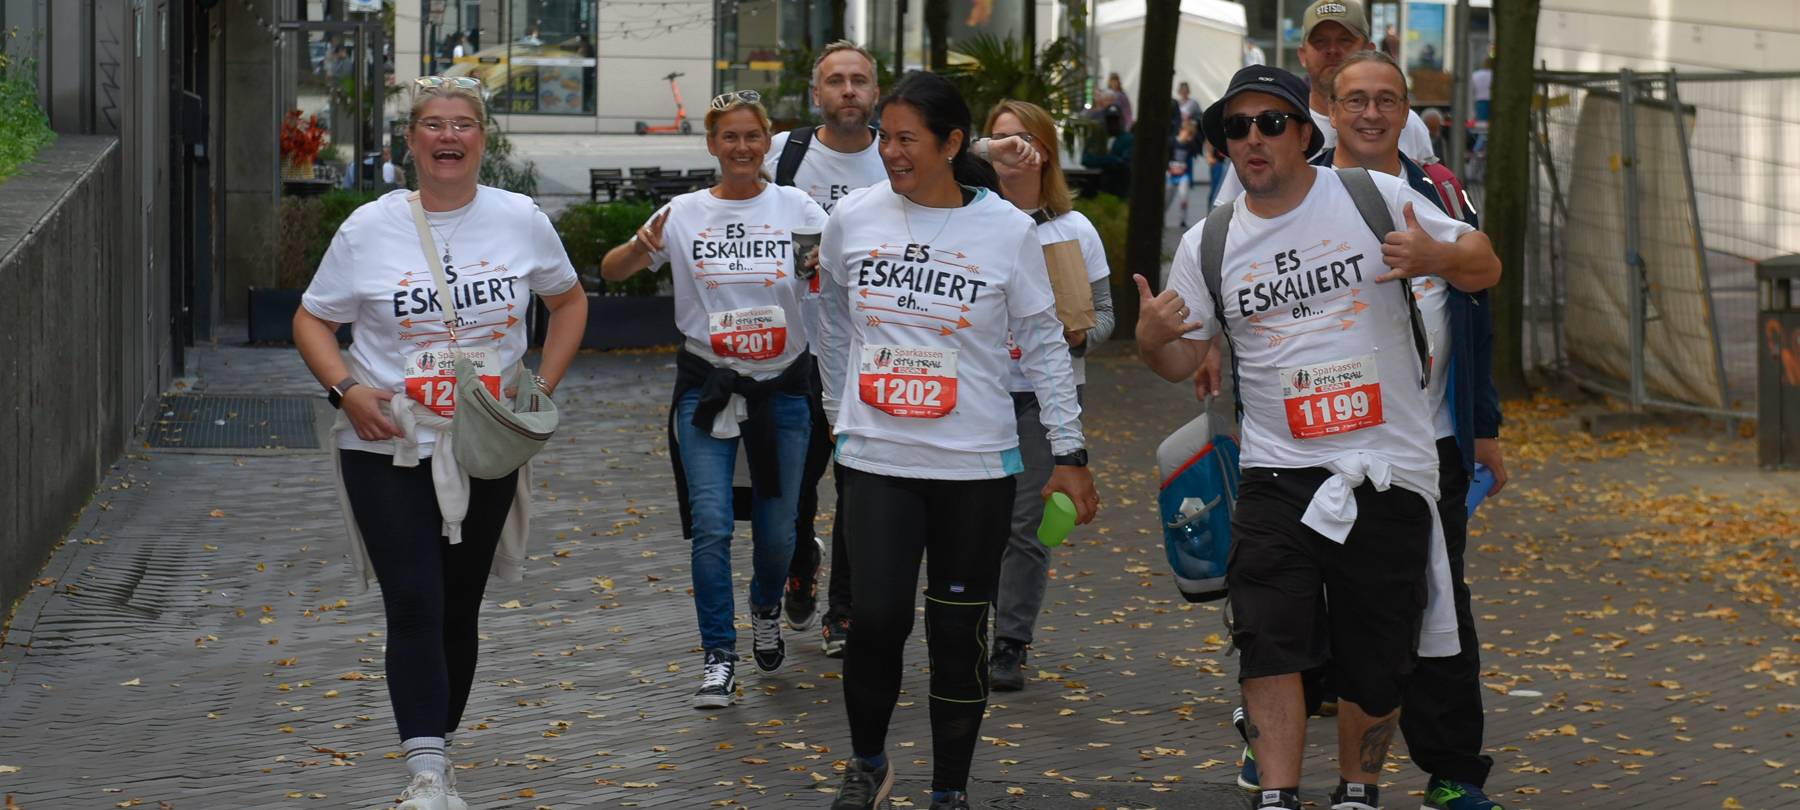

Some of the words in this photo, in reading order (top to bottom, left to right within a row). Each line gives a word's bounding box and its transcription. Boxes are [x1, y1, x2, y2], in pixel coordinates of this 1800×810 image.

[726, 223, 745, 239] ES
[692, 240, 790, 260] ESKALIERT
[903, 243, 930, 263] ES
[728, 260, 753, 271] eh...
[1274, 249, 1301, 275] ES
[445, 265, 458, 284] S
[858, 260, 986, 304] ESKALIERT
[1238, 254, 1364, 317] ESKALIERT
[393, 275, 518, 317] ESKLIERT
[897, 293, 928, 312] eh...
[1292, 302, 1324, 319] eh...
[722, 331, 773, 354] 1201
[894, 348, 943, 359] Sparkassen
[1312, 361, 1362, 376] Sparkassen
[873, 377, 942, 406] 1202
[1299, 391, 1369, 426] 1199
